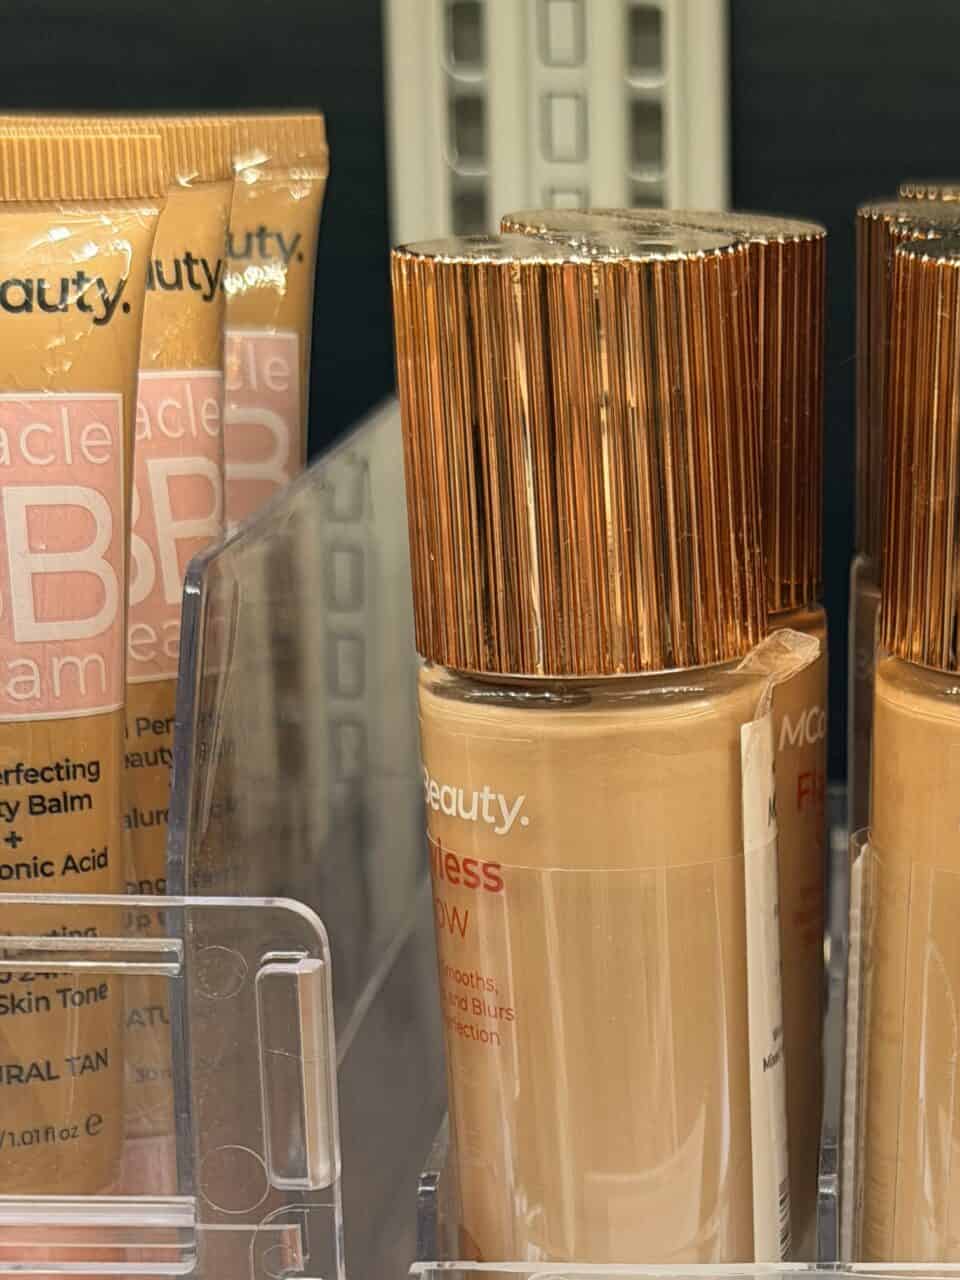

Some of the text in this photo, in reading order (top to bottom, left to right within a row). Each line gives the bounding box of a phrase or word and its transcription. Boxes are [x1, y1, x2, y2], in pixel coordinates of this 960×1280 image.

[0, 758, 100, 786] rfecting
[27, 791, 93, 817] Balm
[424, 768, 529, 835] eauty.
[61, 845, 109, 876] Acid
[431, 837, 505, 893] less
[56, 982, 109, 1009] Tone
[65, 1047, 110, 1077] TAN
